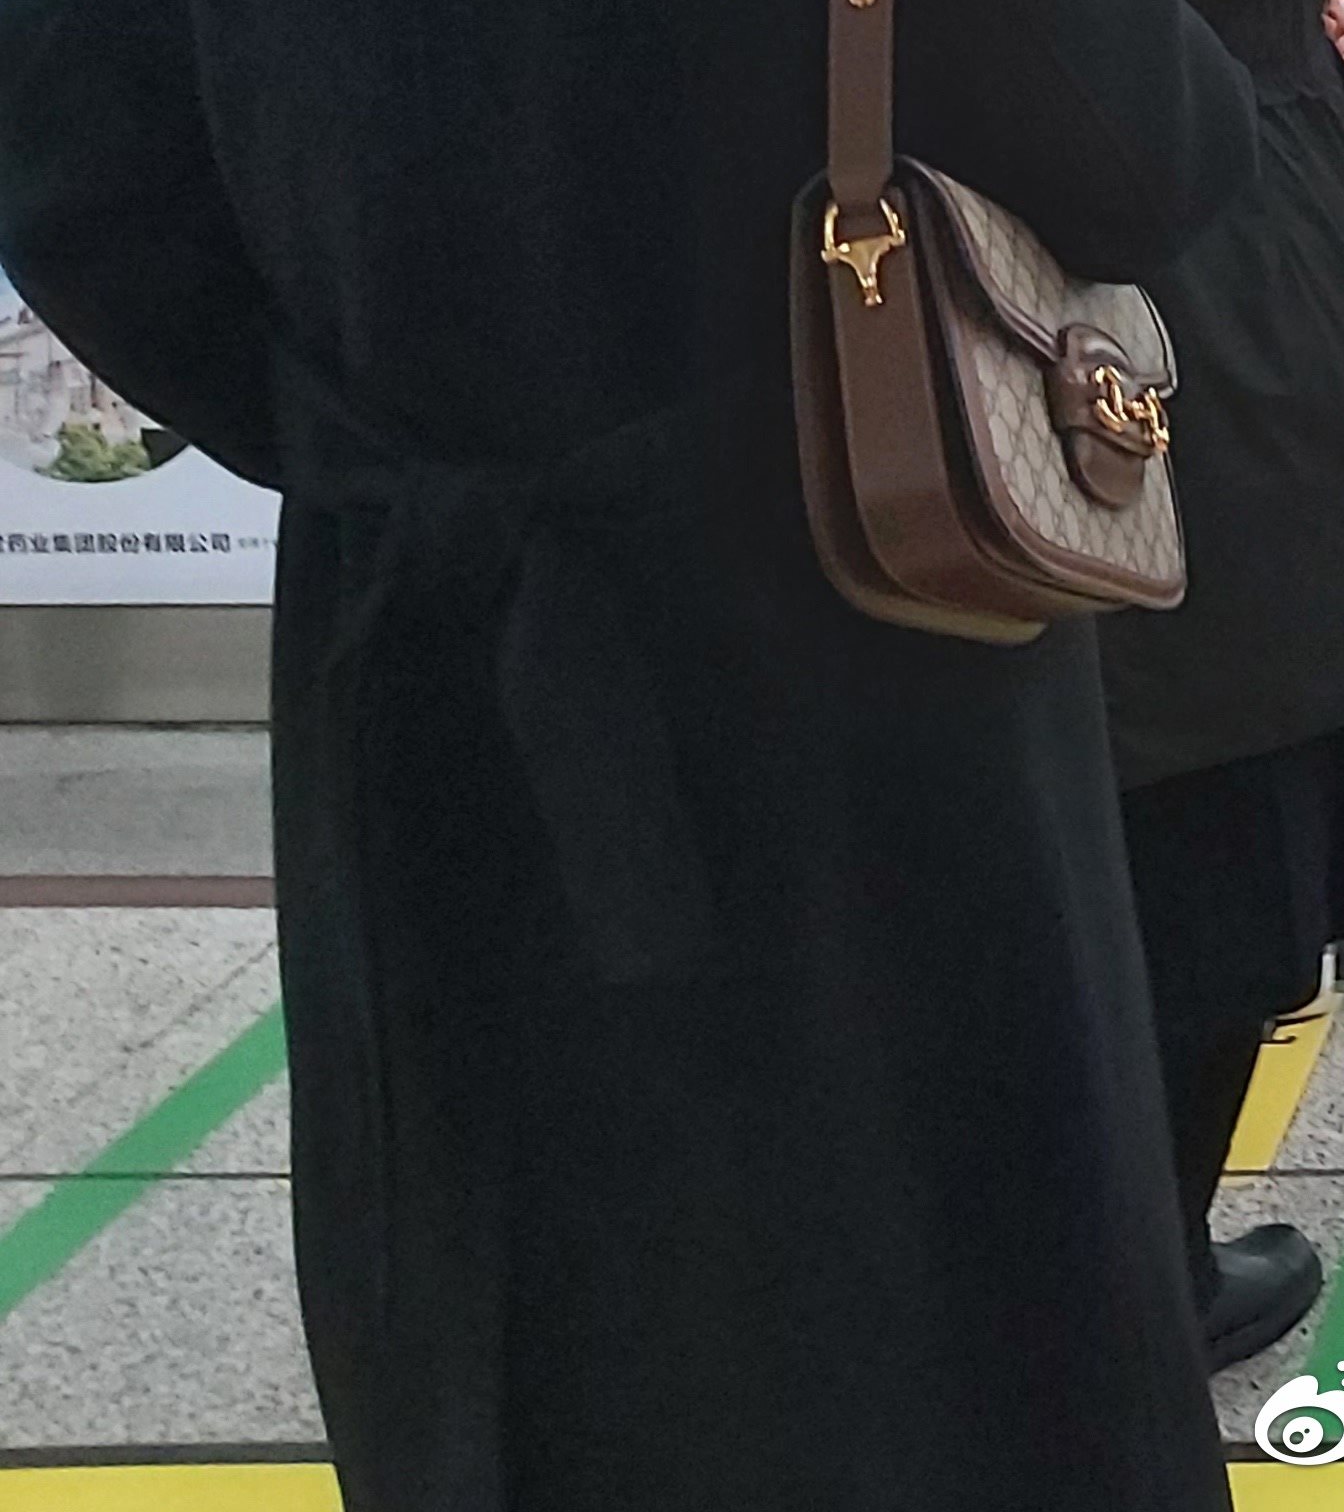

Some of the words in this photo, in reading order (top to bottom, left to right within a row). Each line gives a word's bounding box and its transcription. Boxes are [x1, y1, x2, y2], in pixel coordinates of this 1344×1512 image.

[0, 533, 232, 554] 药业集团股份有限公司
